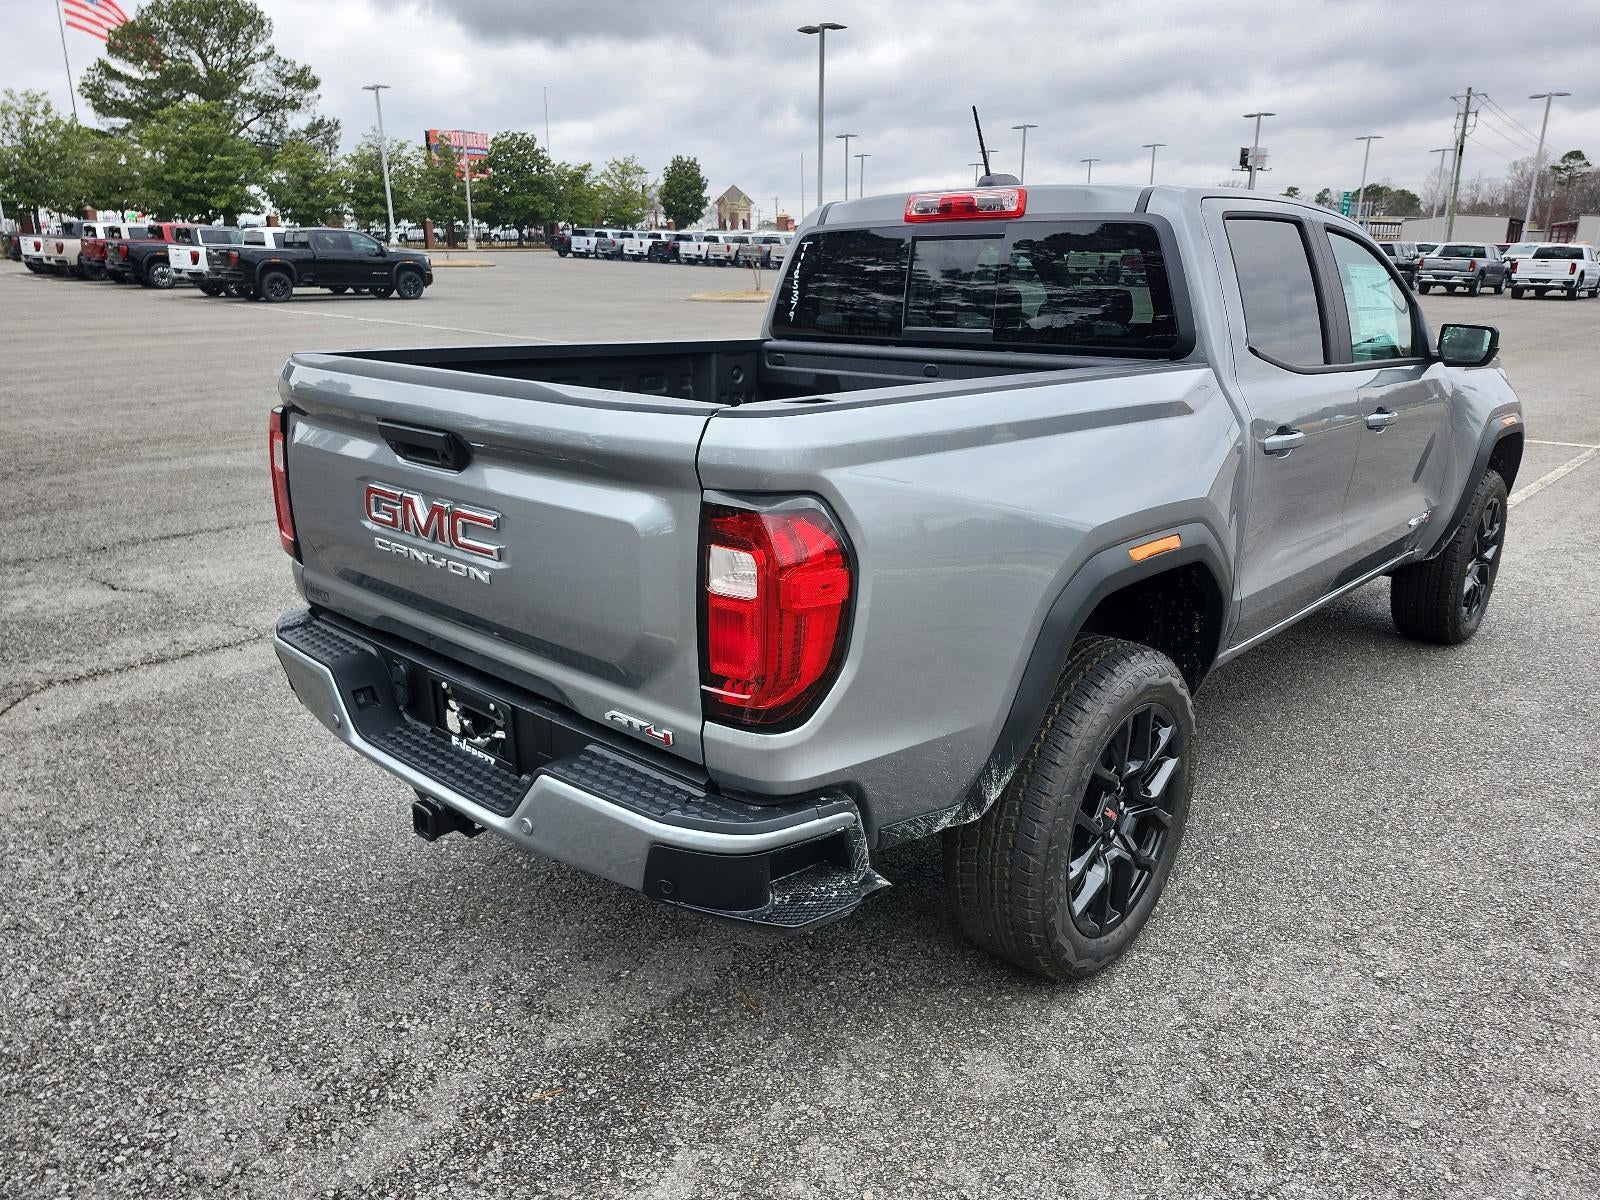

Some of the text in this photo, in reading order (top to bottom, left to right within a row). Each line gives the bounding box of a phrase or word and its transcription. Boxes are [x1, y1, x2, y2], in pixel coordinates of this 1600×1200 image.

[364, 481, 504, 561] GMC
[374, 537, 492, 585] CANYON
[604, 709, 673, 747] AT4
